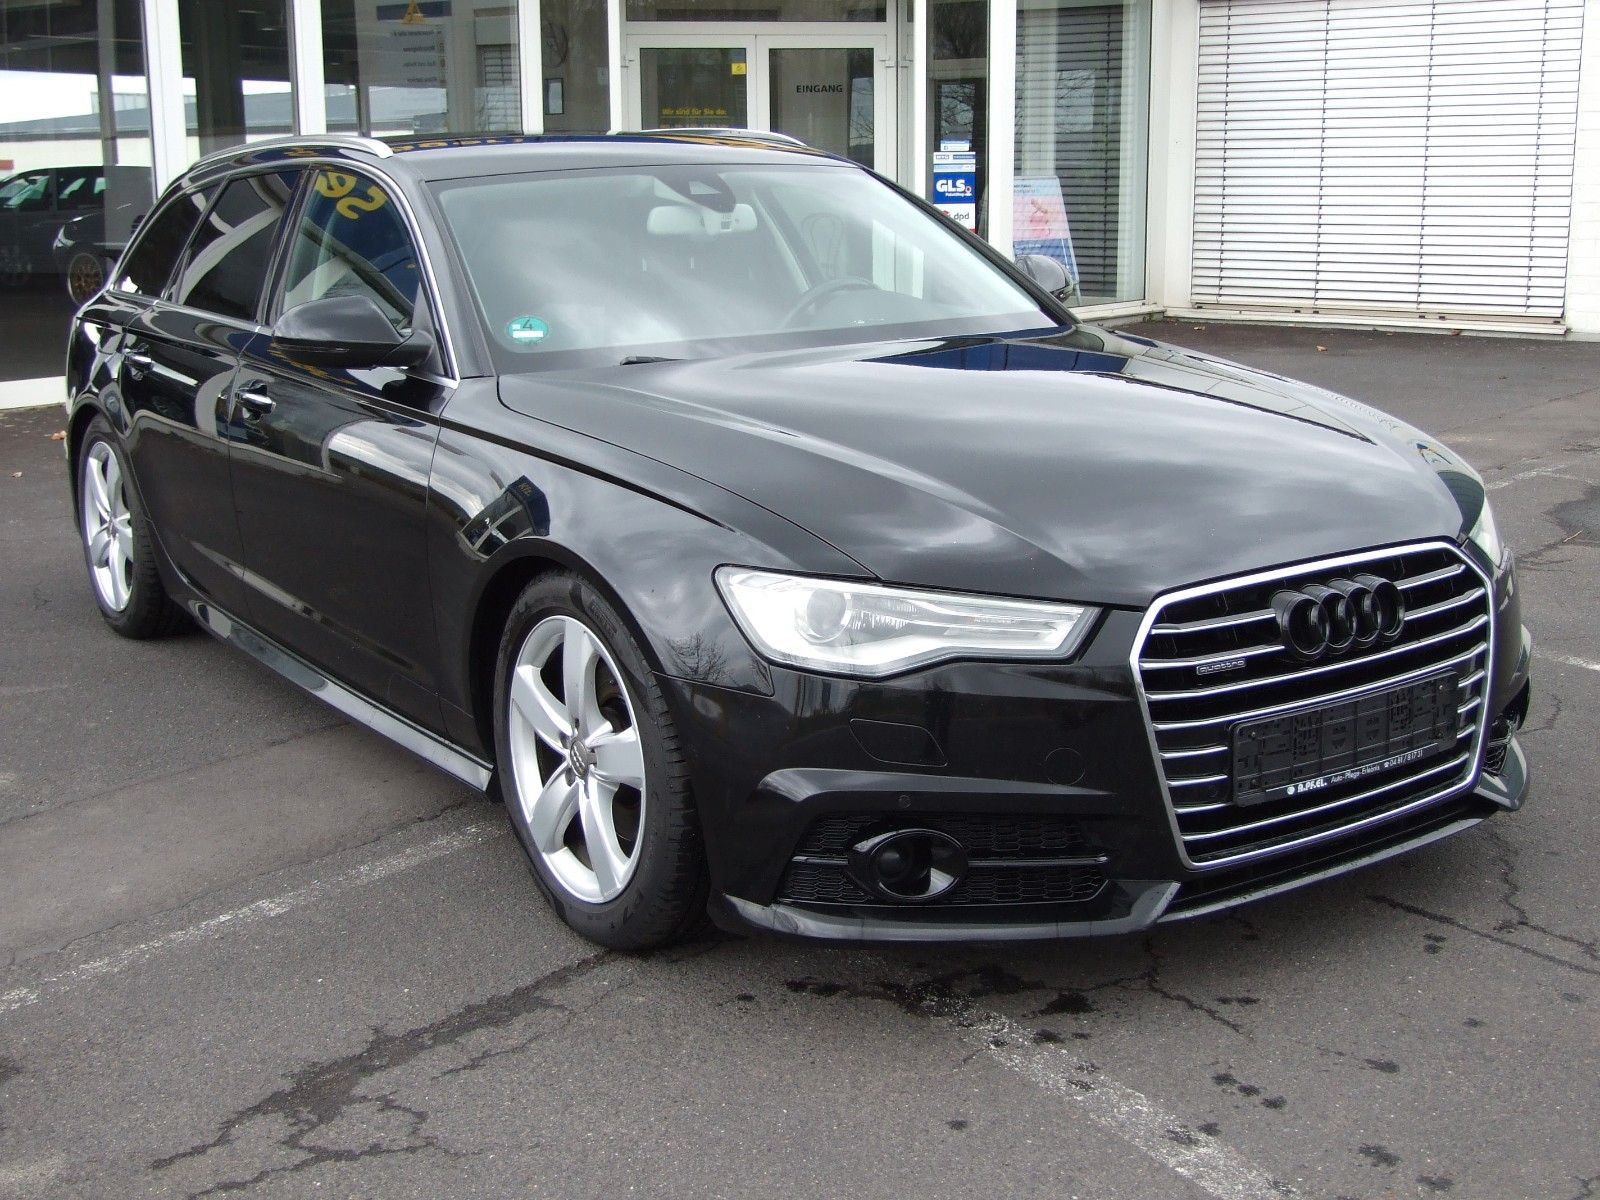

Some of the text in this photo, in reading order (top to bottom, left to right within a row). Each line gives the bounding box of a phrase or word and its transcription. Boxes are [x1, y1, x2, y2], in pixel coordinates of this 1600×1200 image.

[796, 84, 843, 93] EINGANG
[953, 212, 970, 222] dpd
[522, 318, 533, 330] 4
[1199, 660, 1245, 674] quattro
